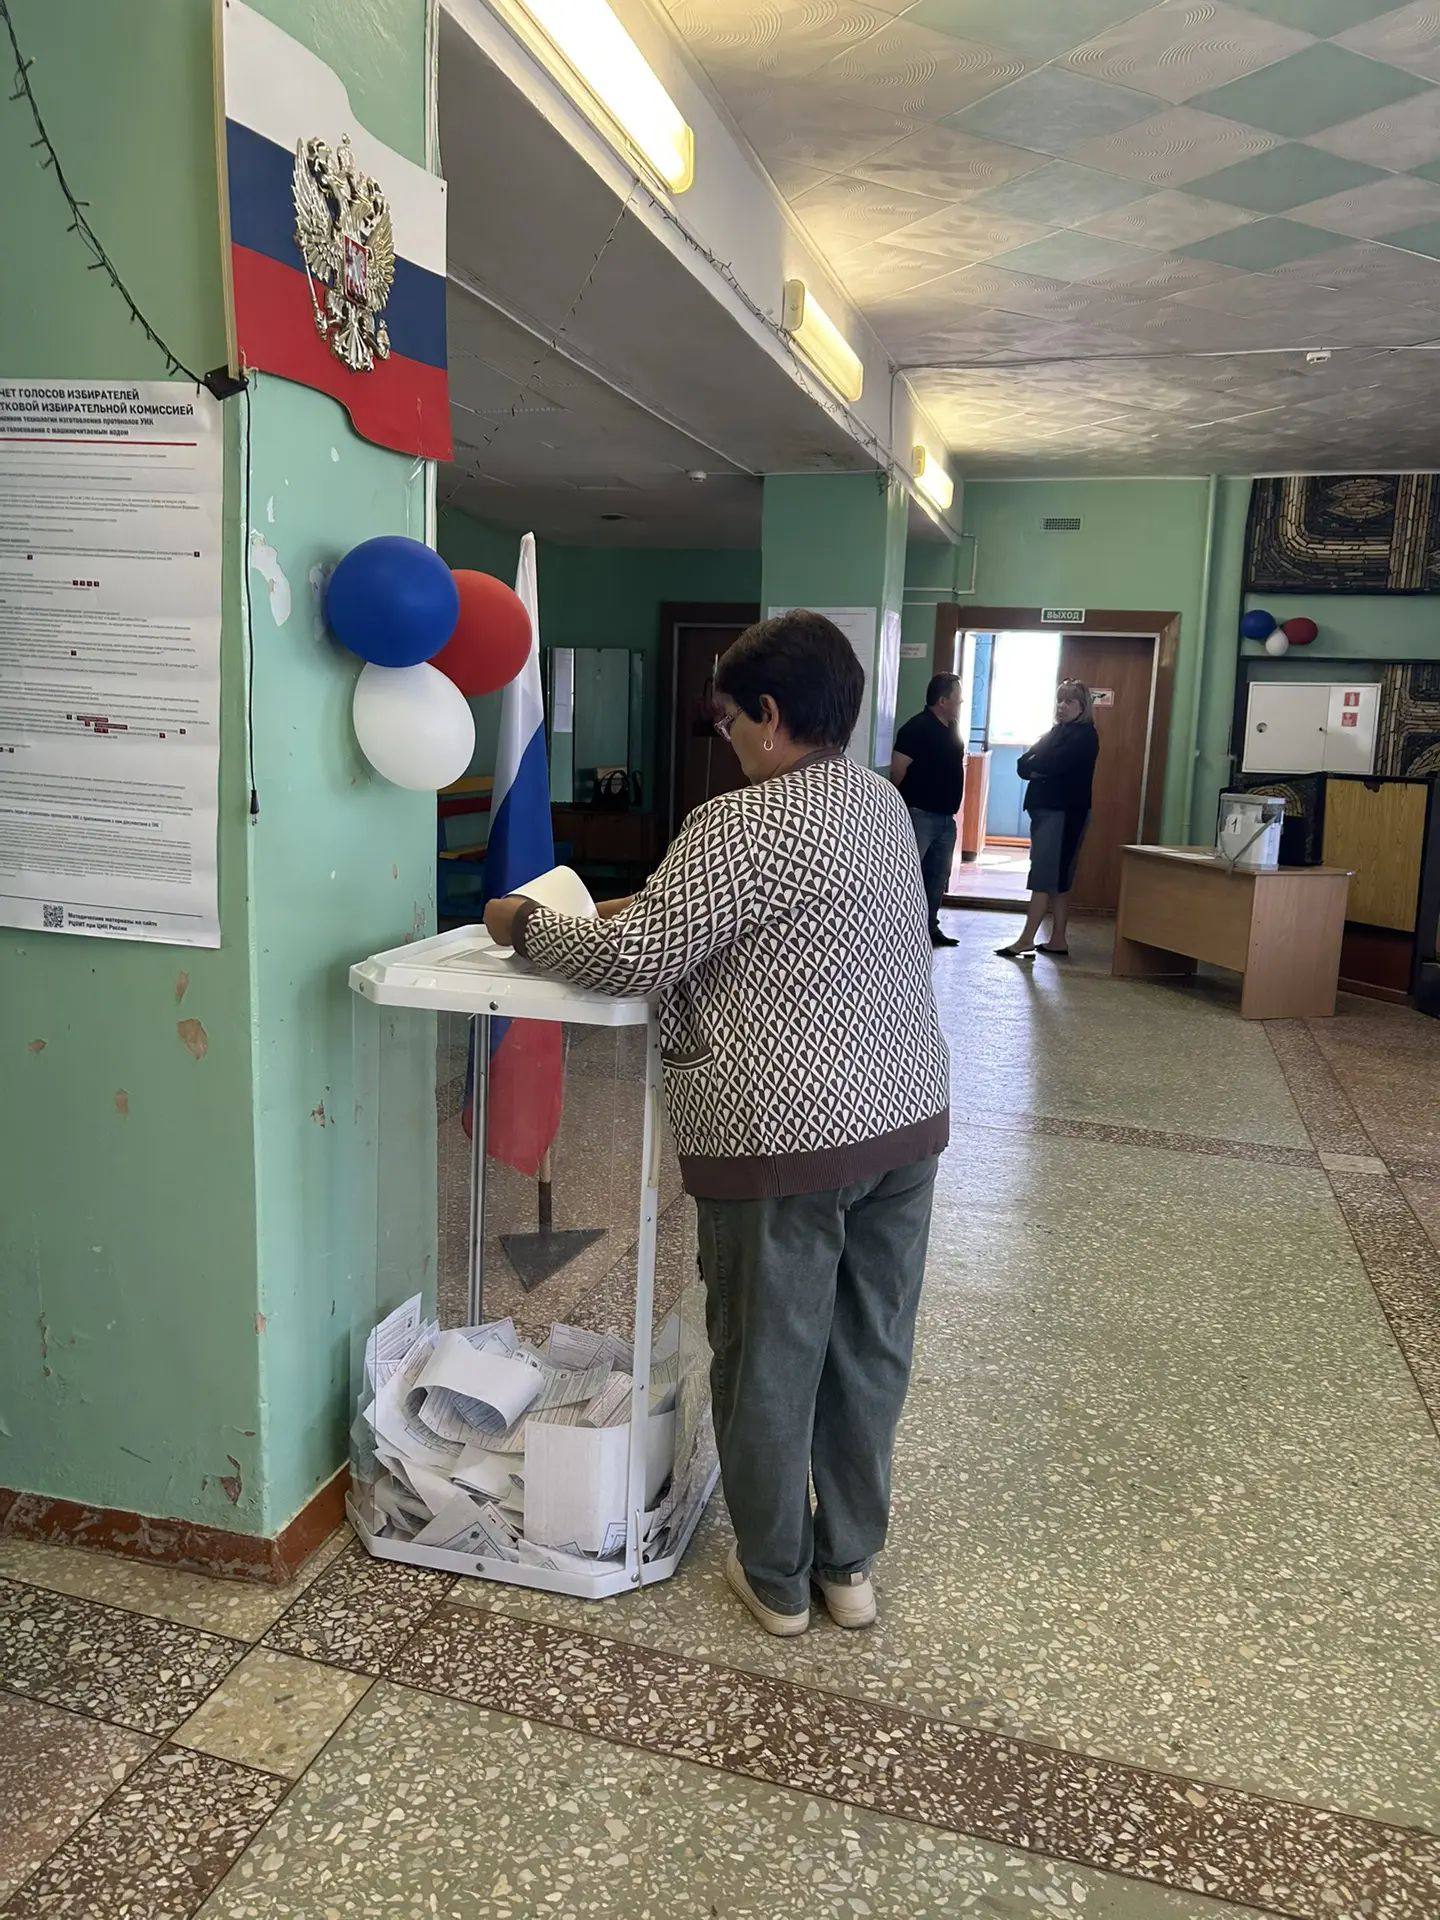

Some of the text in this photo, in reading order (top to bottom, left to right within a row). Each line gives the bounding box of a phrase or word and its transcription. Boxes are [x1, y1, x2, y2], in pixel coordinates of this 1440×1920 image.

[19, 388, 65, 399] ГОЛОСОВ
[67, 388, 139, 400] ИЗБИРАТЕЛЕЙ
[41, 402, 127, 414] ИЗБИРАТЕЛЬНОЙ
[130, 404, 194, 415] КОМИССИЕЙ
[52, 427, 108, 435] машиночитаемым
[1046, 611, 1080, 621] ВЫХОД
[1232, 817, 1238, 832] 1
[68, 912, 104, 921] Методические
[105, 917, 134, 925] материалы
